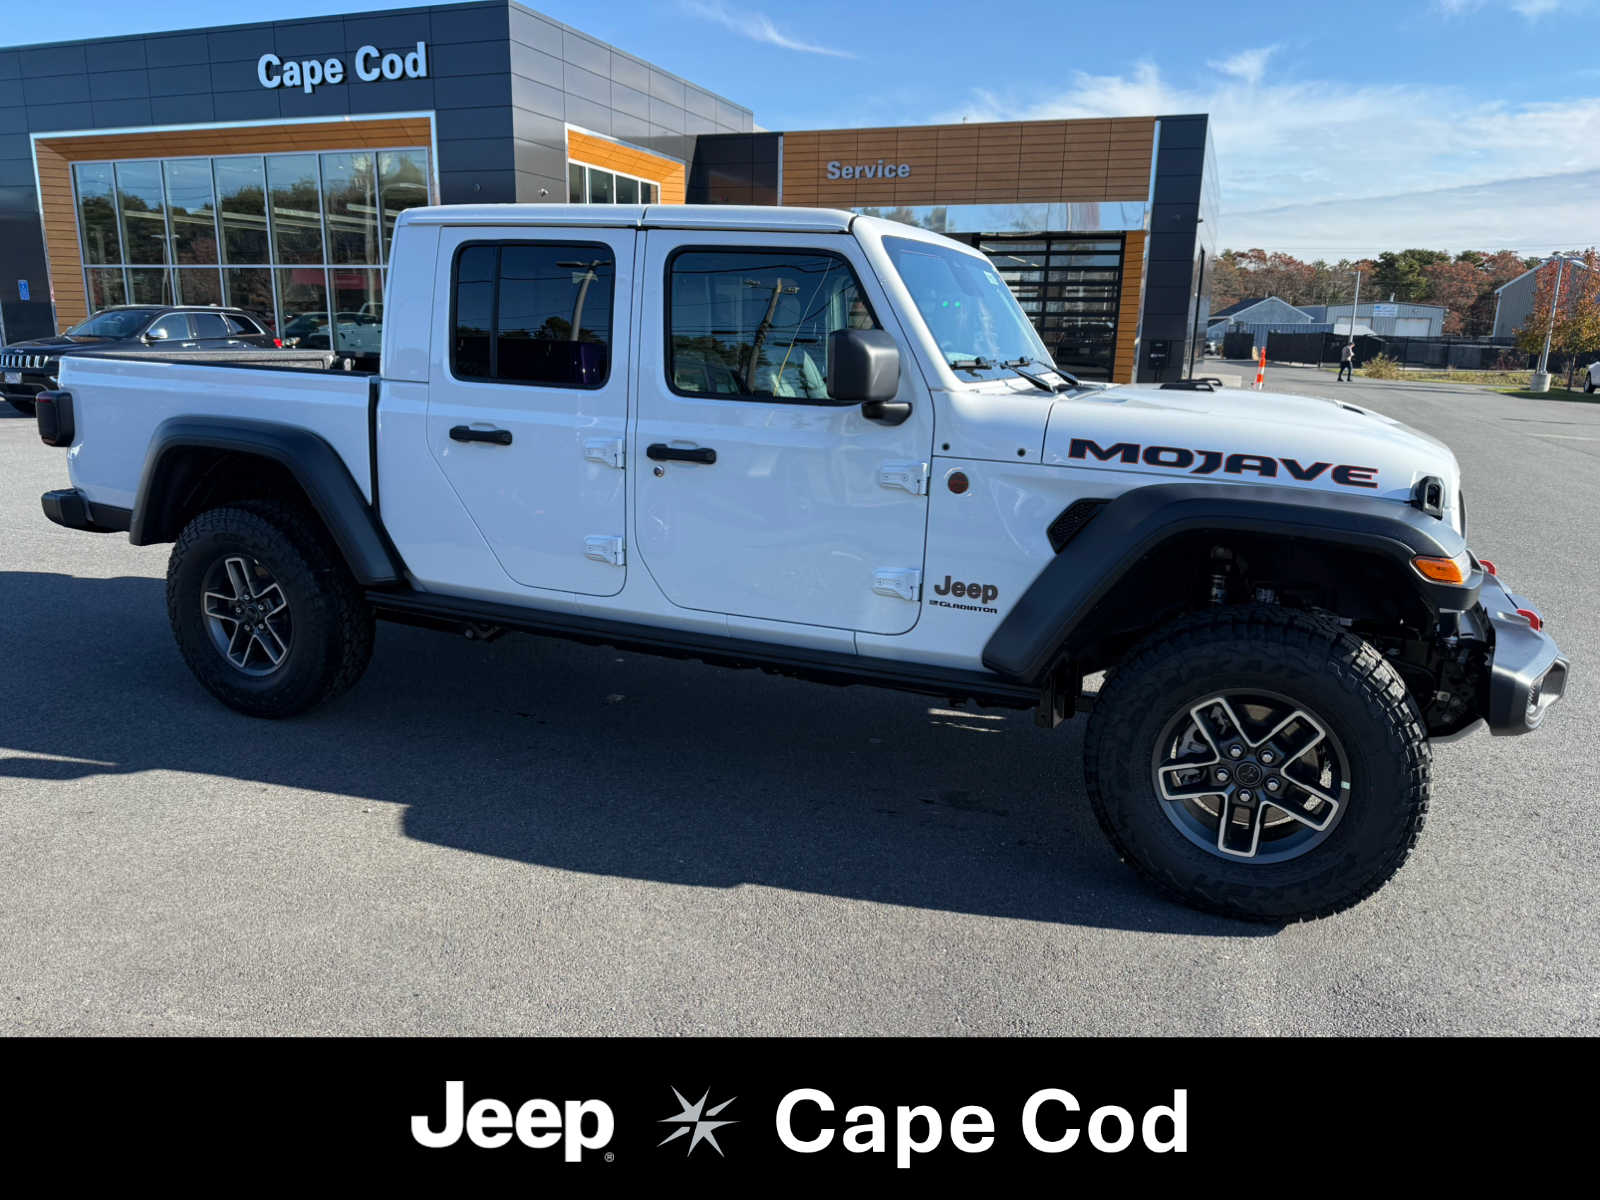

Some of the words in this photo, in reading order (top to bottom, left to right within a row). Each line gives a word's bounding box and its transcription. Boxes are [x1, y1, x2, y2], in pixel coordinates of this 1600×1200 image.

[257, 53, 344, 94] Cape
[355, 41, 428, 82] Cod
[827, 160, 911, 180] Service
[1067, 437, 1379, 489] MOJAVE
[934, 575, 999, 605] Jeep
[938, 601, 999, 614] GLADIATOR
